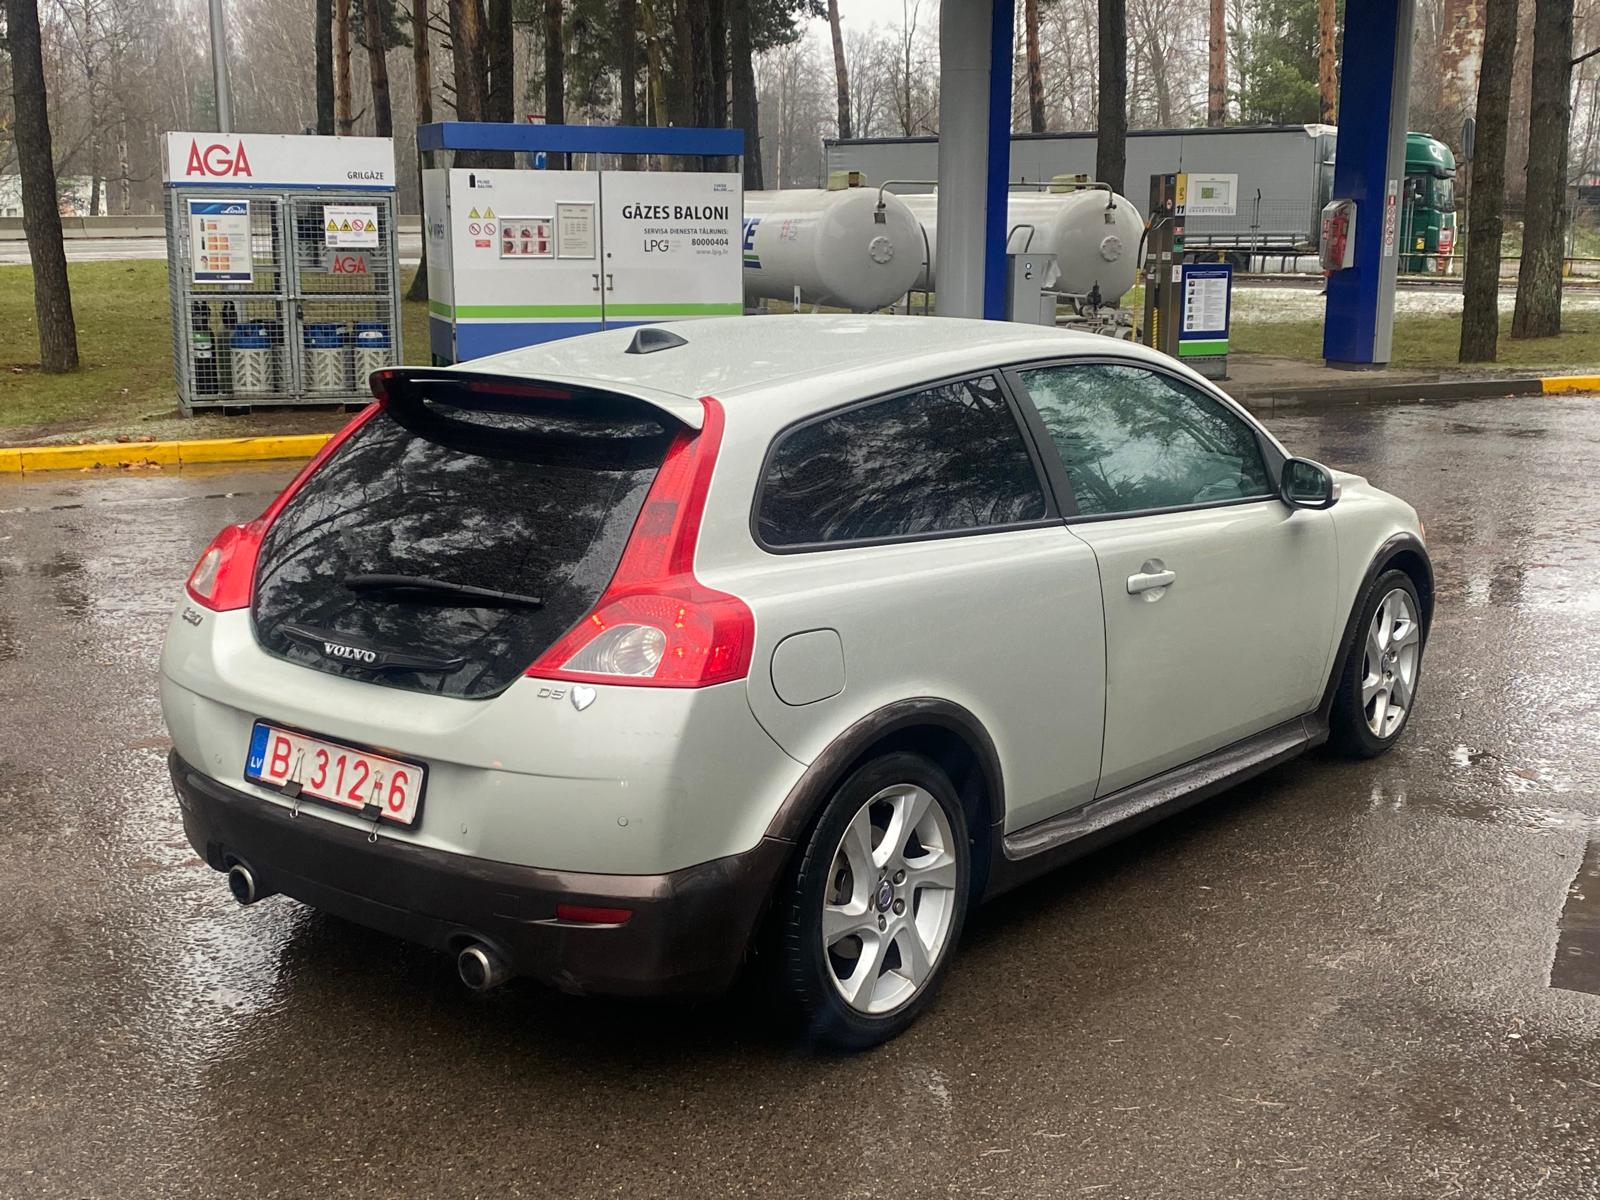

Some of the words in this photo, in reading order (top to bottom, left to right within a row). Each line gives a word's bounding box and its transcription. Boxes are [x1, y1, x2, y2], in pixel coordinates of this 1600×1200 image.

[186, 137, 252, 177] AGA
[347, 170, 384, 181] GRILGĀZE
[622, 202, 670, 220] GĀZES
[674, 206, 729, 220] BALONI
[1176, 205, 1185, 214] 11
[644, 239, 669, 253] LPG
[691, 238, 729, 246] 80000404
[333, 255, 367, 273] AGA
[324, 642, 376, 663] VOLVO
[250, 756, 263, 769] LV
